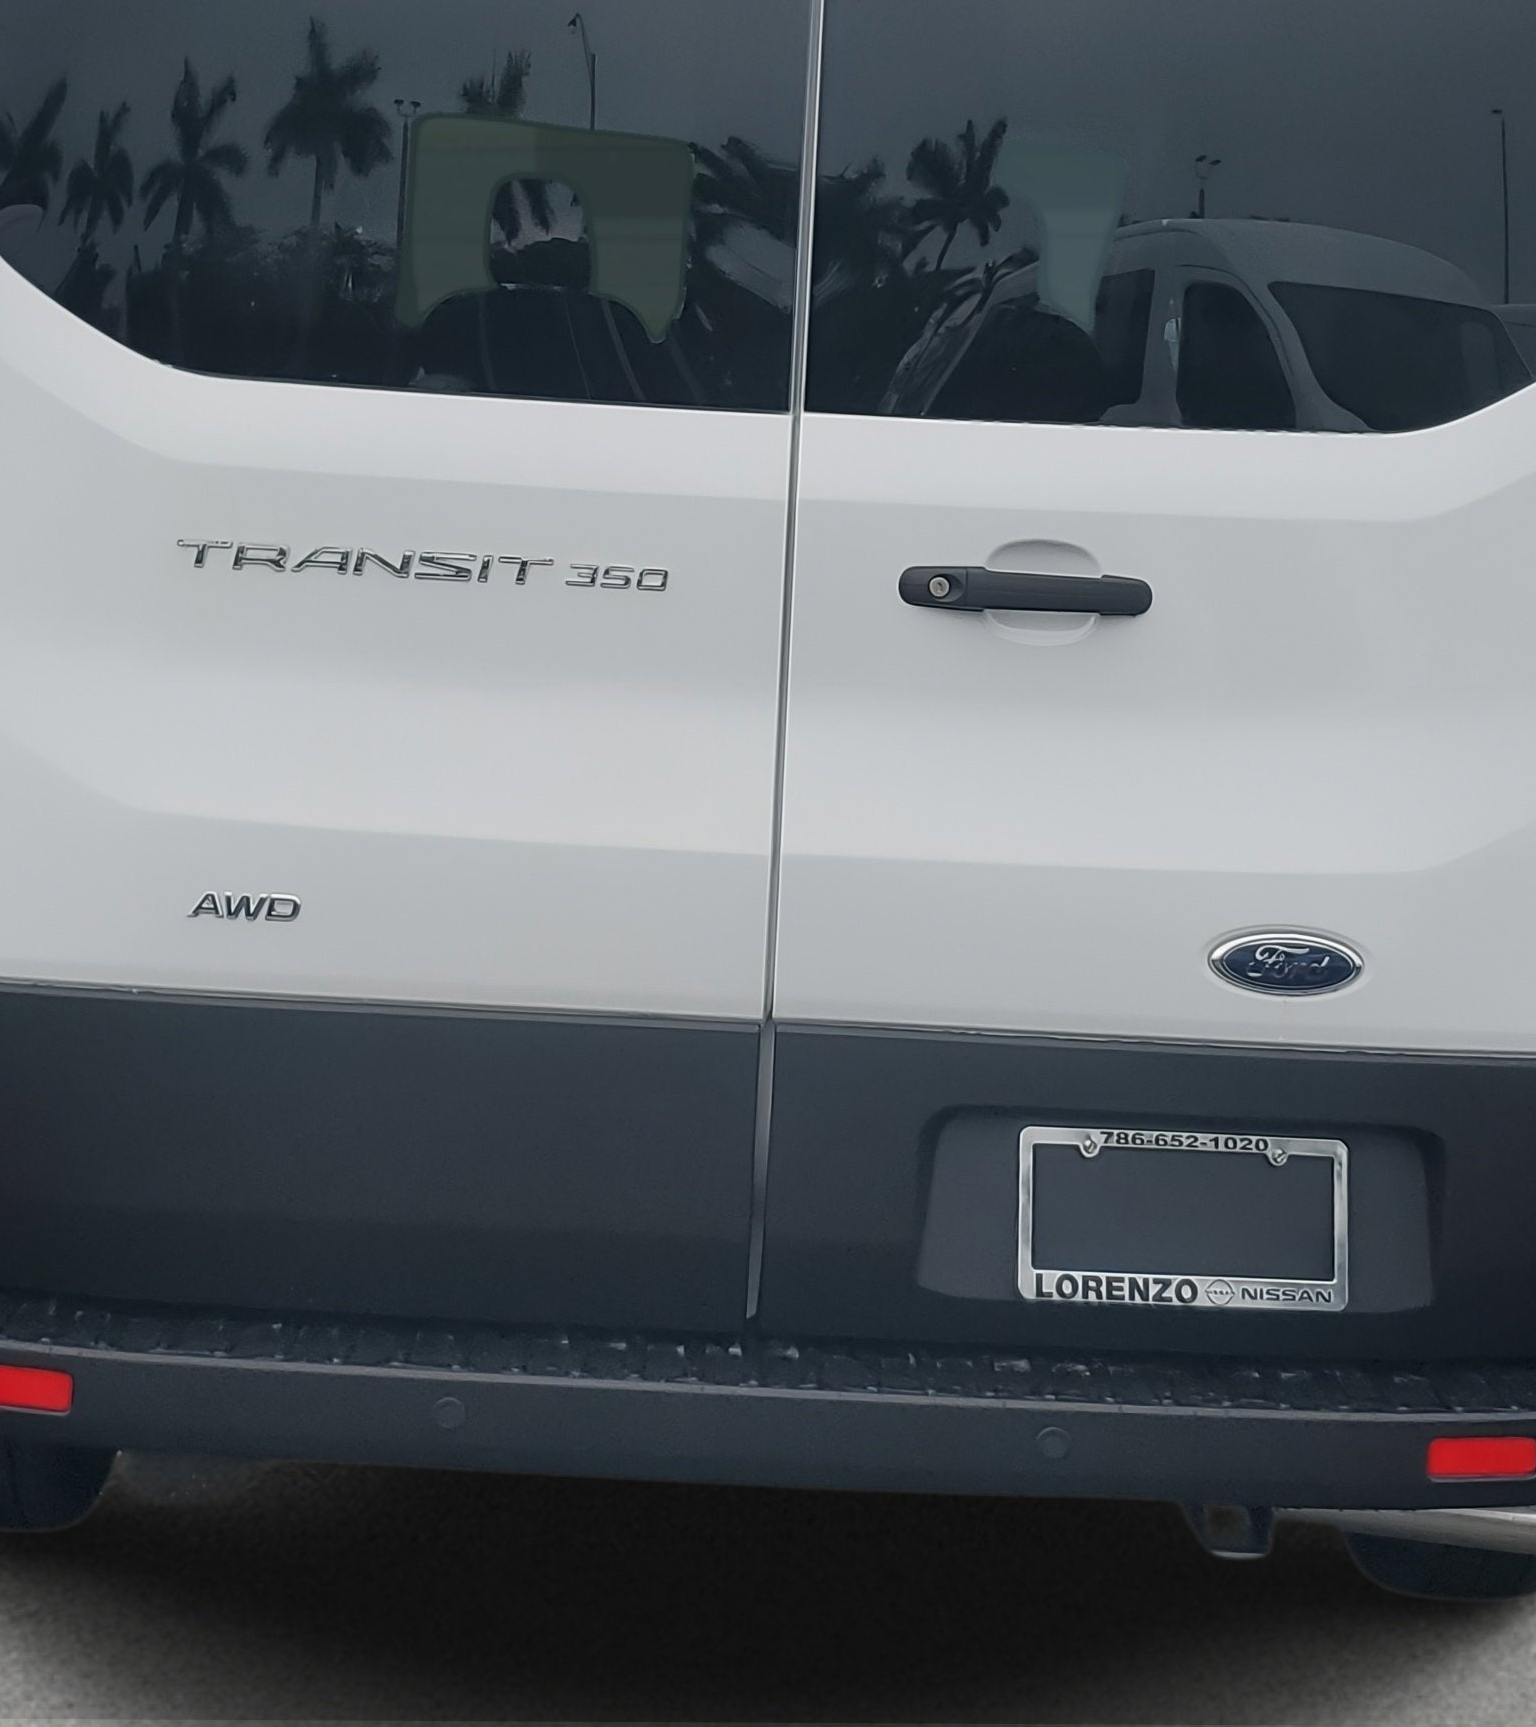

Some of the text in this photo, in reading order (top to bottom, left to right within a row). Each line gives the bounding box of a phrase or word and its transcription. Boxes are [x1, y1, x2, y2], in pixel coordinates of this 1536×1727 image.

[176, 538, 669, 592] TRANSIT 350
[186, 890, 301, 922] AWD
[1245, 944, 1331, 979] Ford
[1100, 1131, 1269, 1151] 786-652-1020
[1034, 1273, 1332, 1304] LORENZO NISSAN
